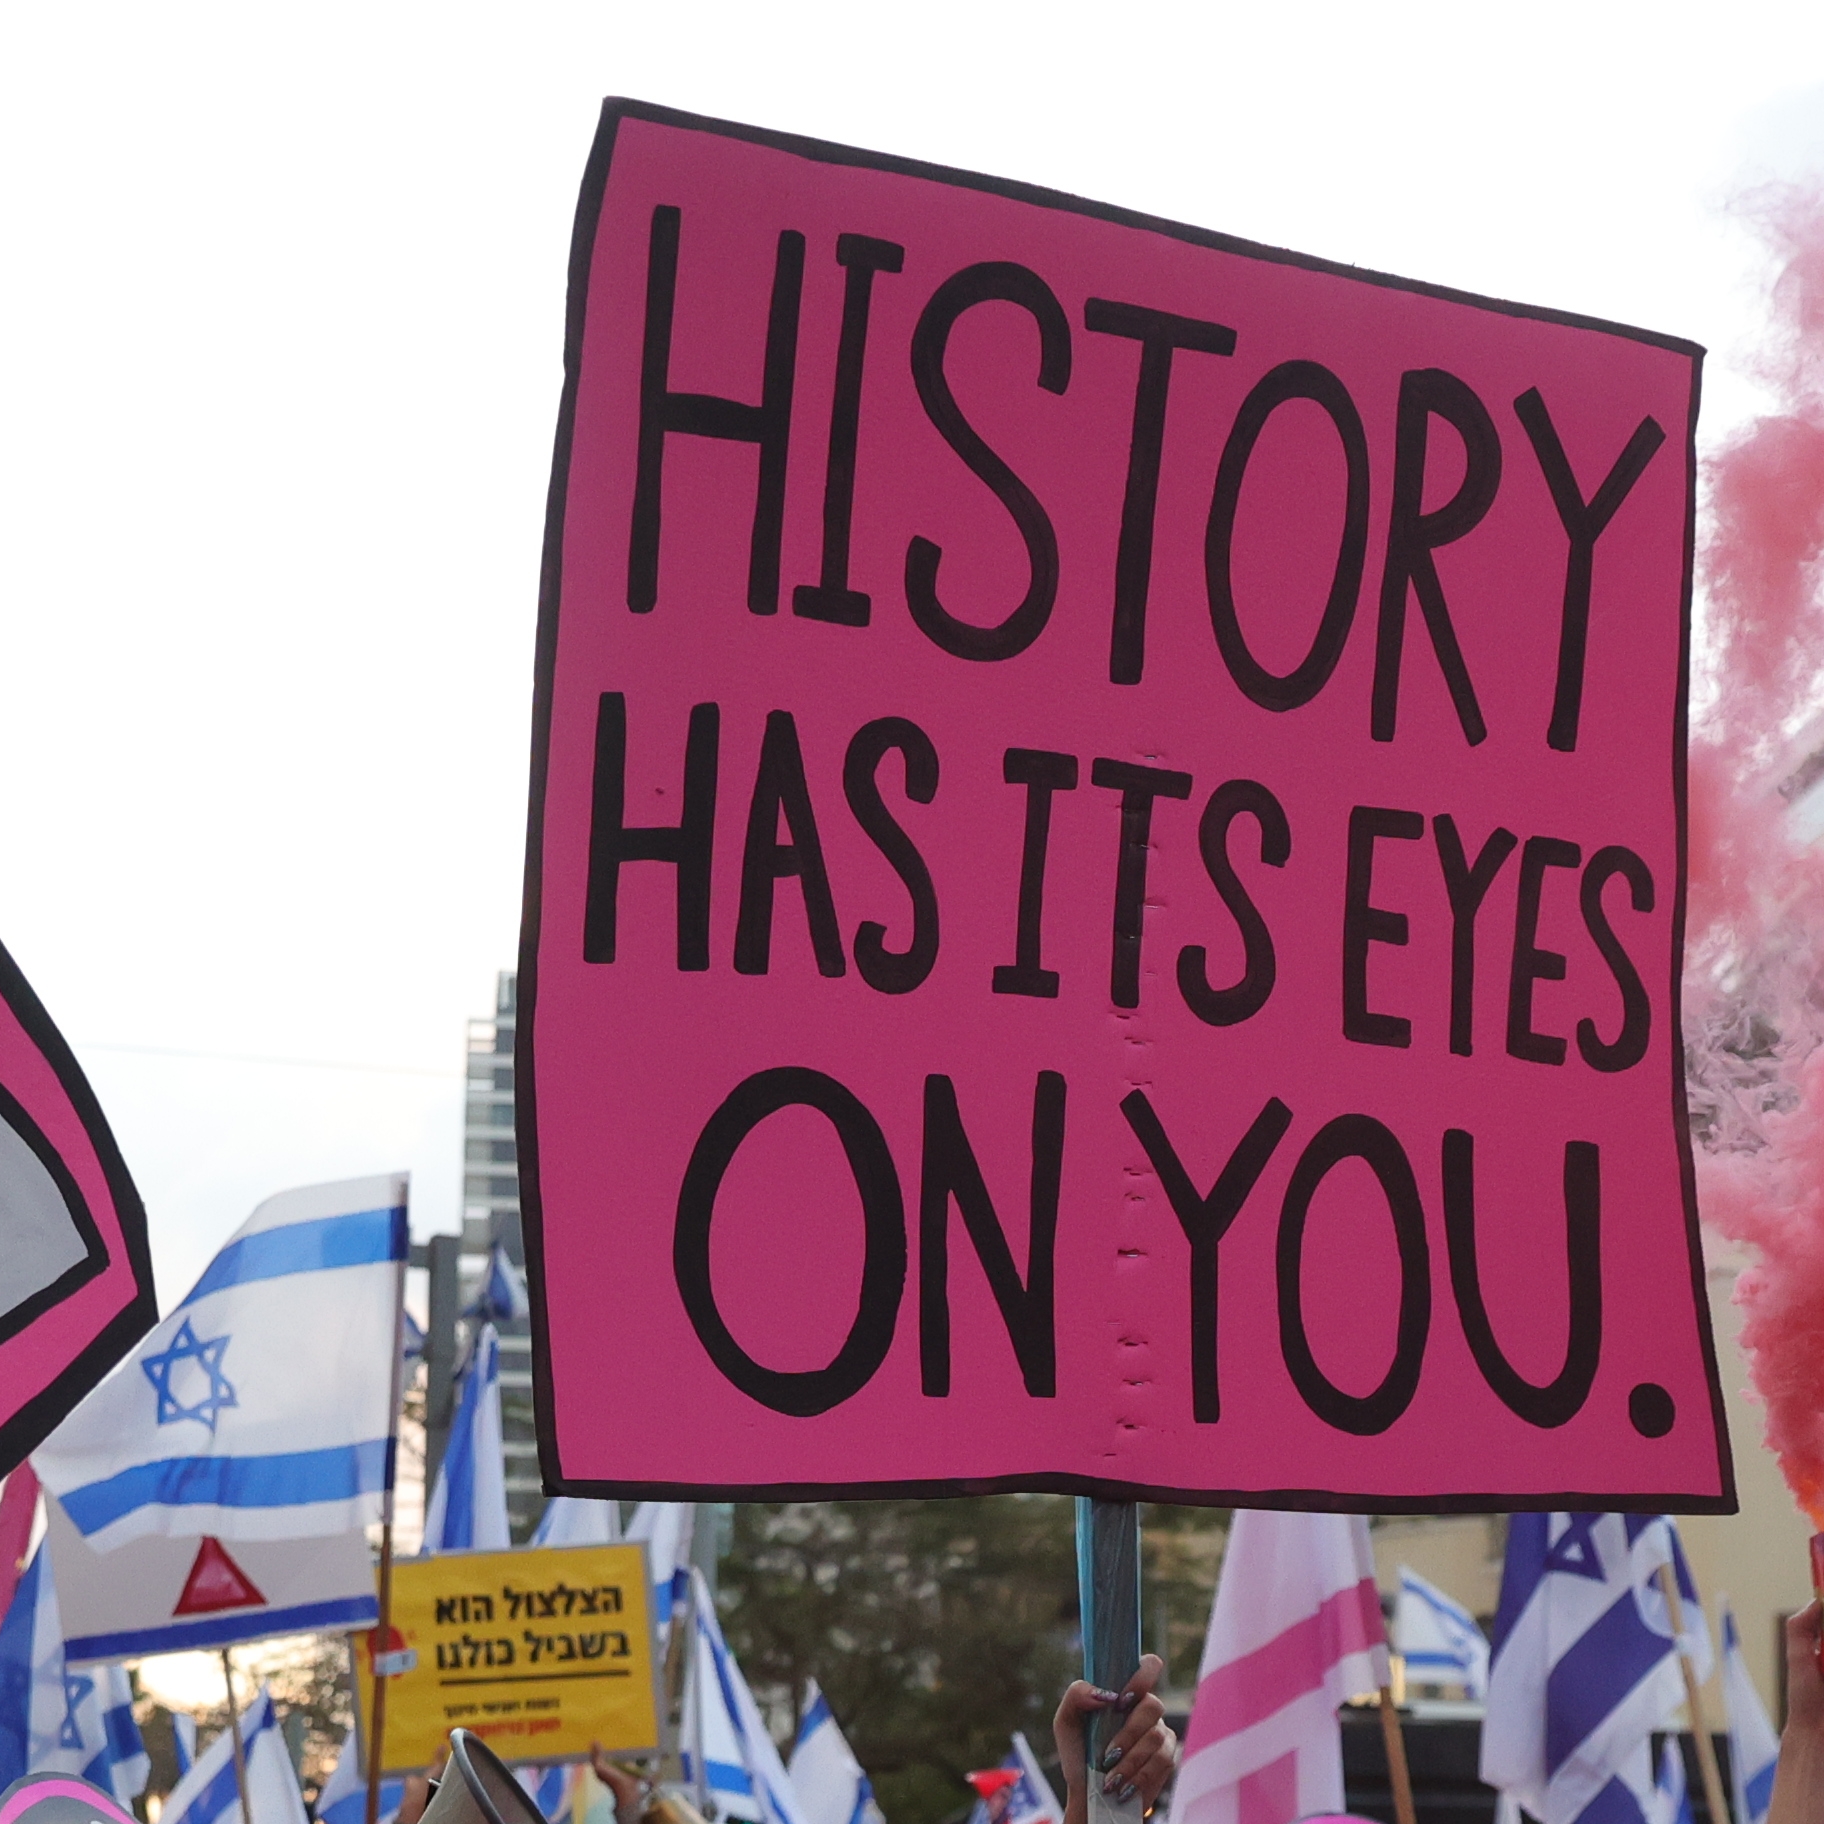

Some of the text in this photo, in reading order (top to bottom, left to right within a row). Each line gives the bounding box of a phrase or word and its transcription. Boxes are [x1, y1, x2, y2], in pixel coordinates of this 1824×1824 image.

[627, 204, 1666, 752] HISTORY
[583, 691, 1655, 1074] HAS ITS EYES
[673, 1066, 1676, 1439] ON YOU.
[434, 1582, 623, 1625] הצלצול הוא
[436, 1629, 631, 1671] בשביל כולנו
